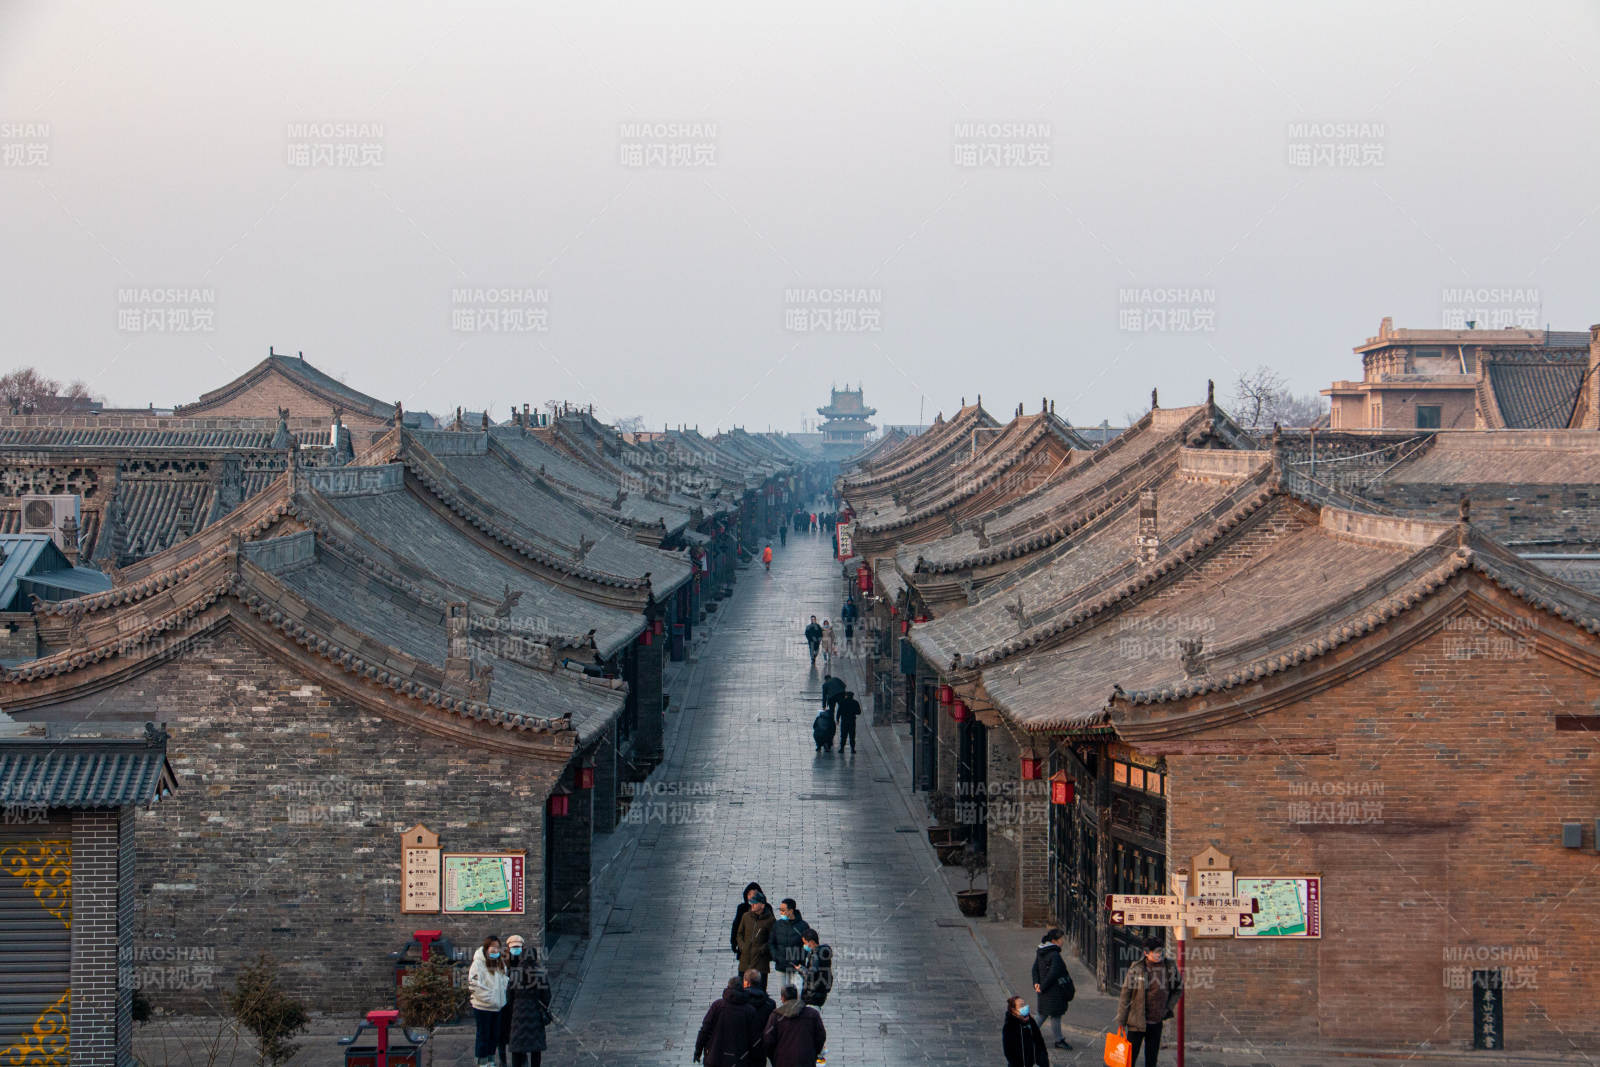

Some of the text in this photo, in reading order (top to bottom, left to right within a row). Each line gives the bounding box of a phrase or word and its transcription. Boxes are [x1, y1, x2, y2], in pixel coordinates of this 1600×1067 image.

[1123, 896, 1166, 905] 西南门头街
[1198, 898, 1241, 907] 东南门头街
